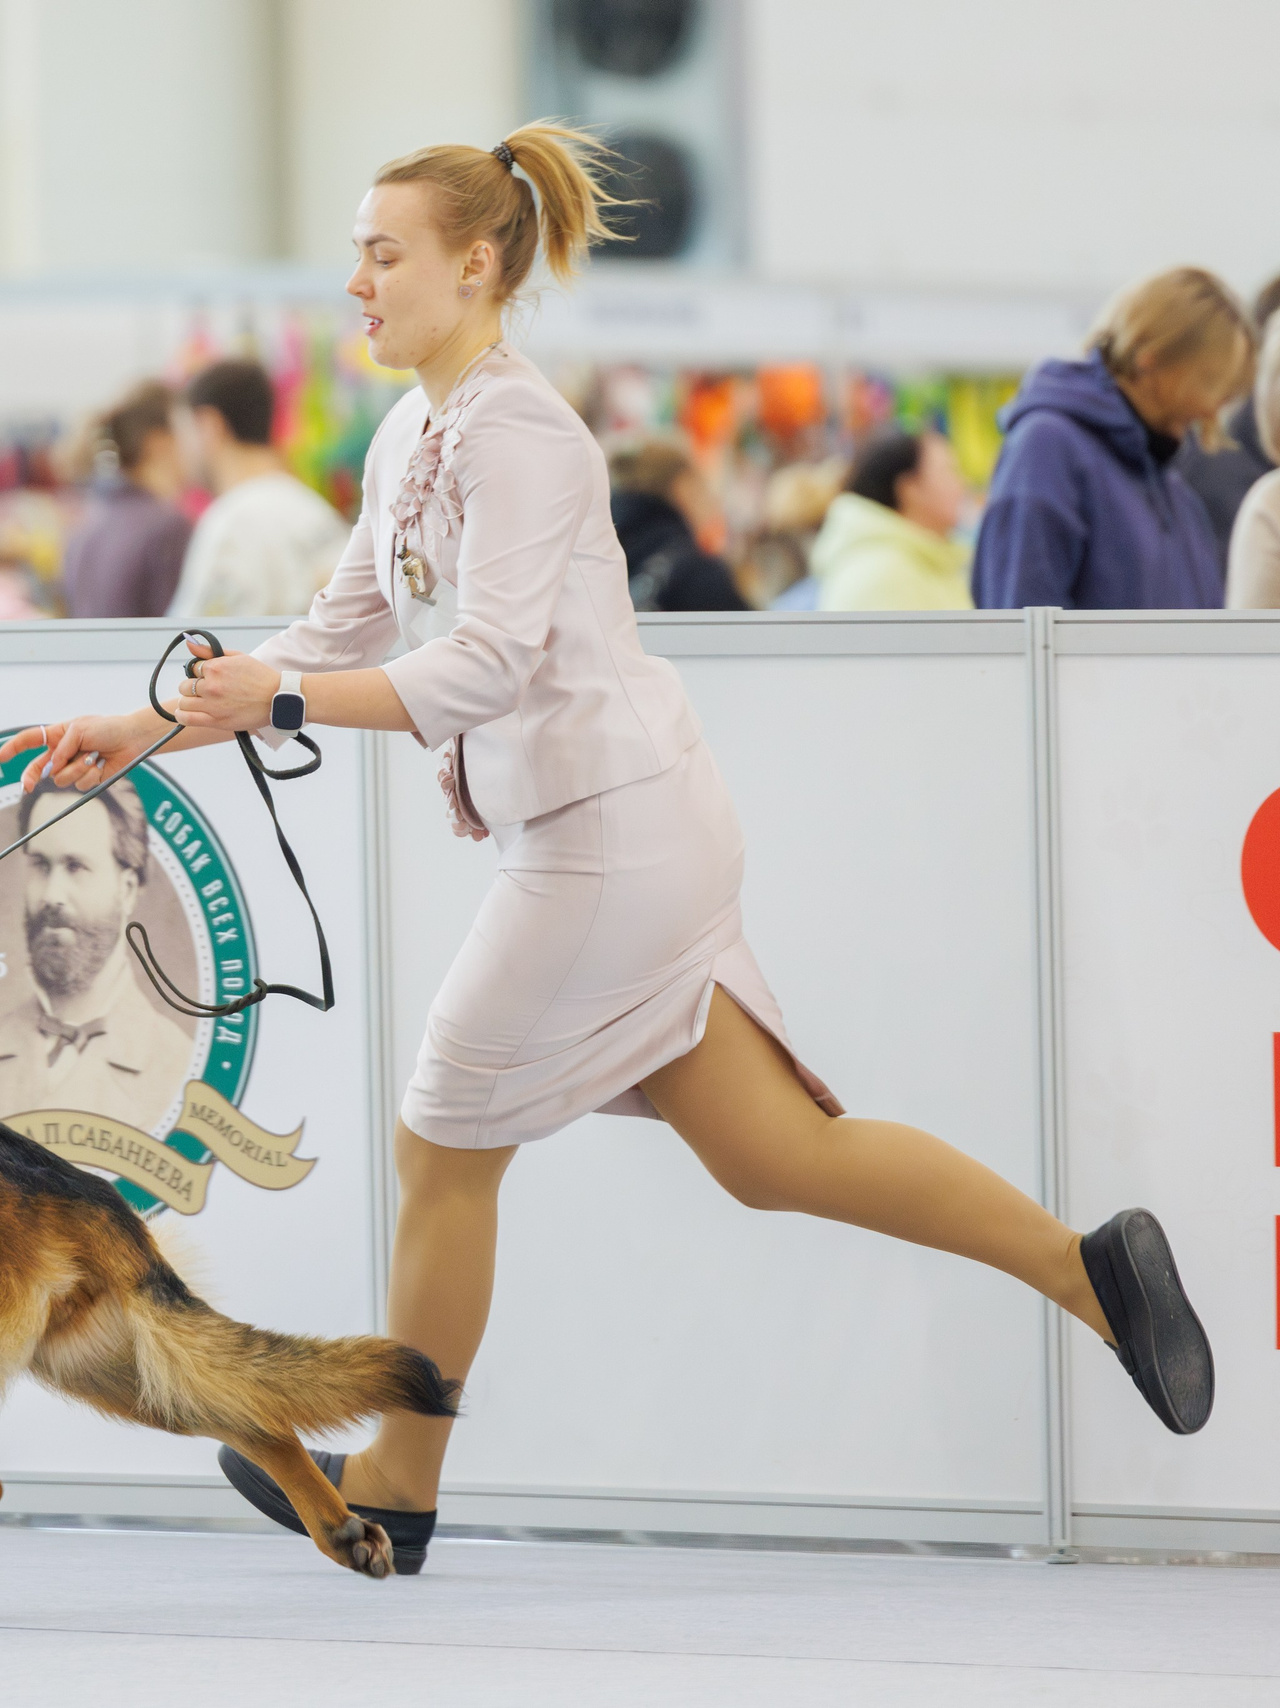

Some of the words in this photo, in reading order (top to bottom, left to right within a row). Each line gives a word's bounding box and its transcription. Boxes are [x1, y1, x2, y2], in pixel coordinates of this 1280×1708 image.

[153, 800, 212, 874] СОБАК
[201, 879, 239, 944] ВСЕХ
[188, 1101, 289, 1168] MEMORIAL
